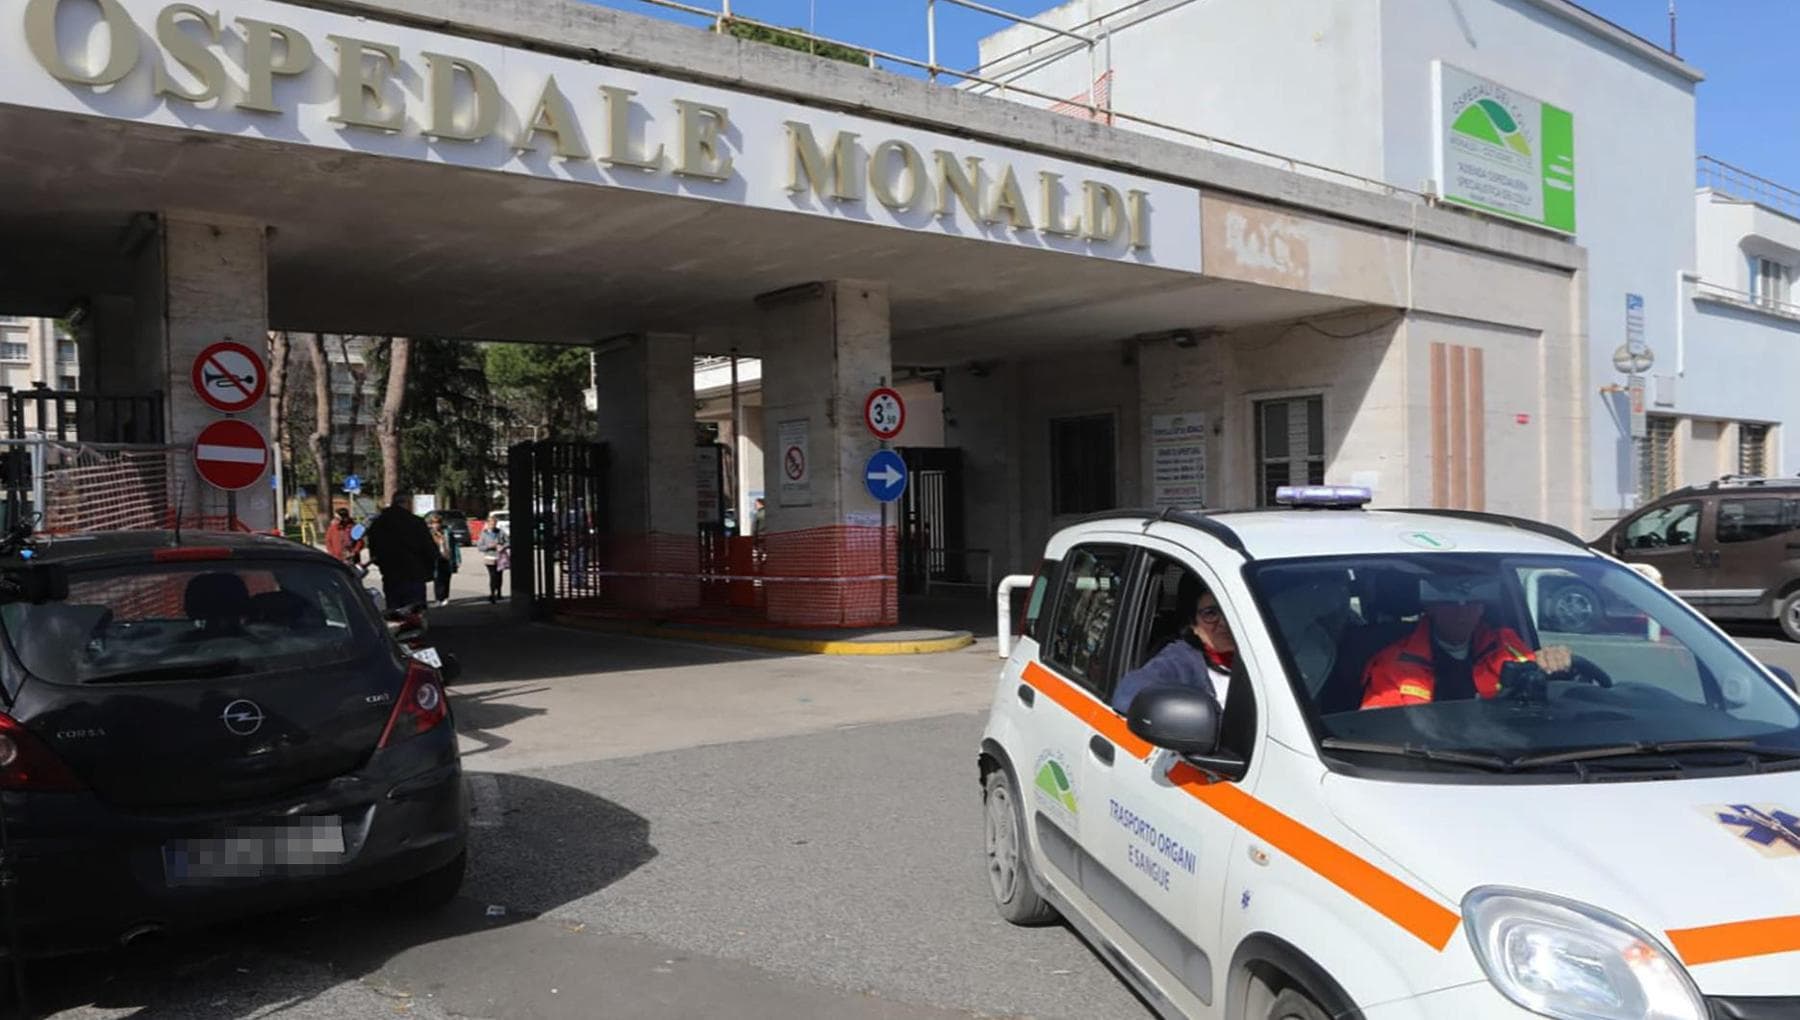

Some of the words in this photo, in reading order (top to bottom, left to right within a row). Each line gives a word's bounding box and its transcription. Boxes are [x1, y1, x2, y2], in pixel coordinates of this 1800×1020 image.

[24, 0, 735, 183] OSPEDALE
[782, 118, 1152, 252] MONALDI
[874, 403, 884, 424] 3
[56, 727, 106, 740] CORSA
[1109, 798, 1158, 847] TRASPORTO
[1157, 833, 1197, 875] ORGANI
[1134, 847, 1171, 892] SANGUE
